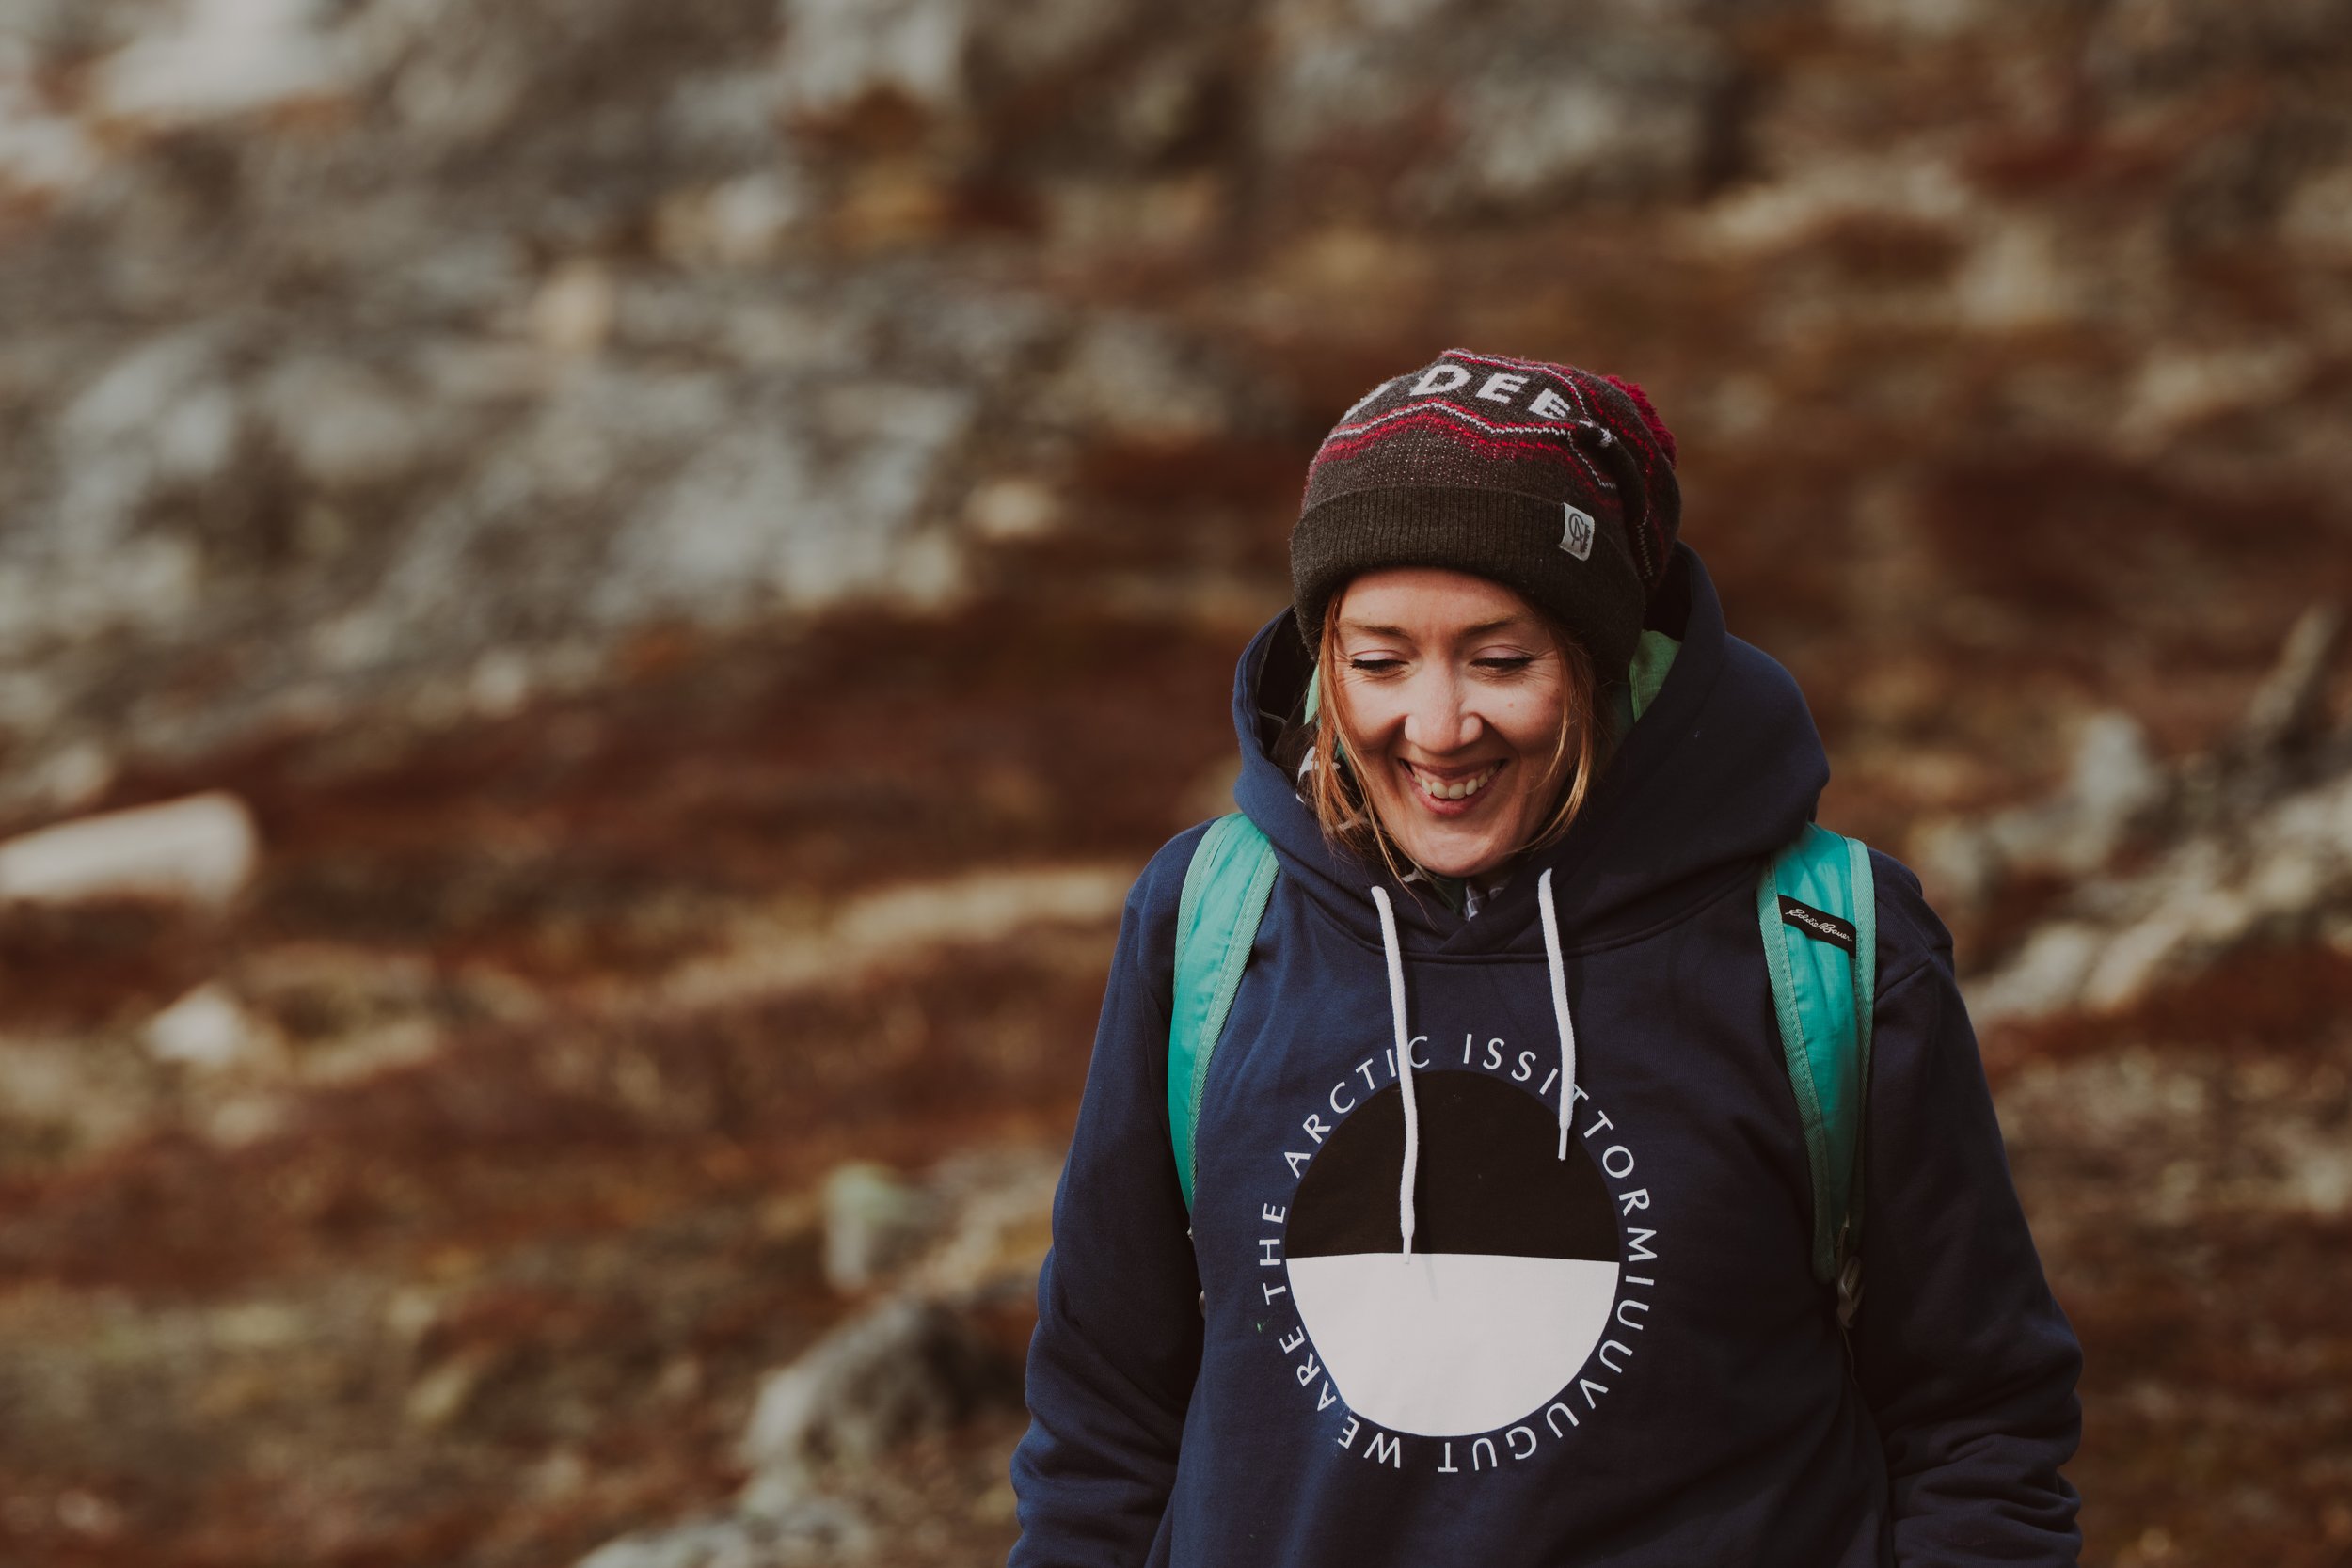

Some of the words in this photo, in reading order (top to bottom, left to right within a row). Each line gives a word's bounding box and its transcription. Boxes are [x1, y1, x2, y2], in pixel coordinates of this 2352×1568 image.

[1785, 908, 1820, 928] Eddie
[1818, 922, 1852, 942] Bauer
[1284, 1035, 1430, 1179] ARCTIC
[1259, 1202, 1287, 1305] THE
[1279, 1326, 1337, 1412] ARE
[1338, 1416, 1401, 1469] WE
